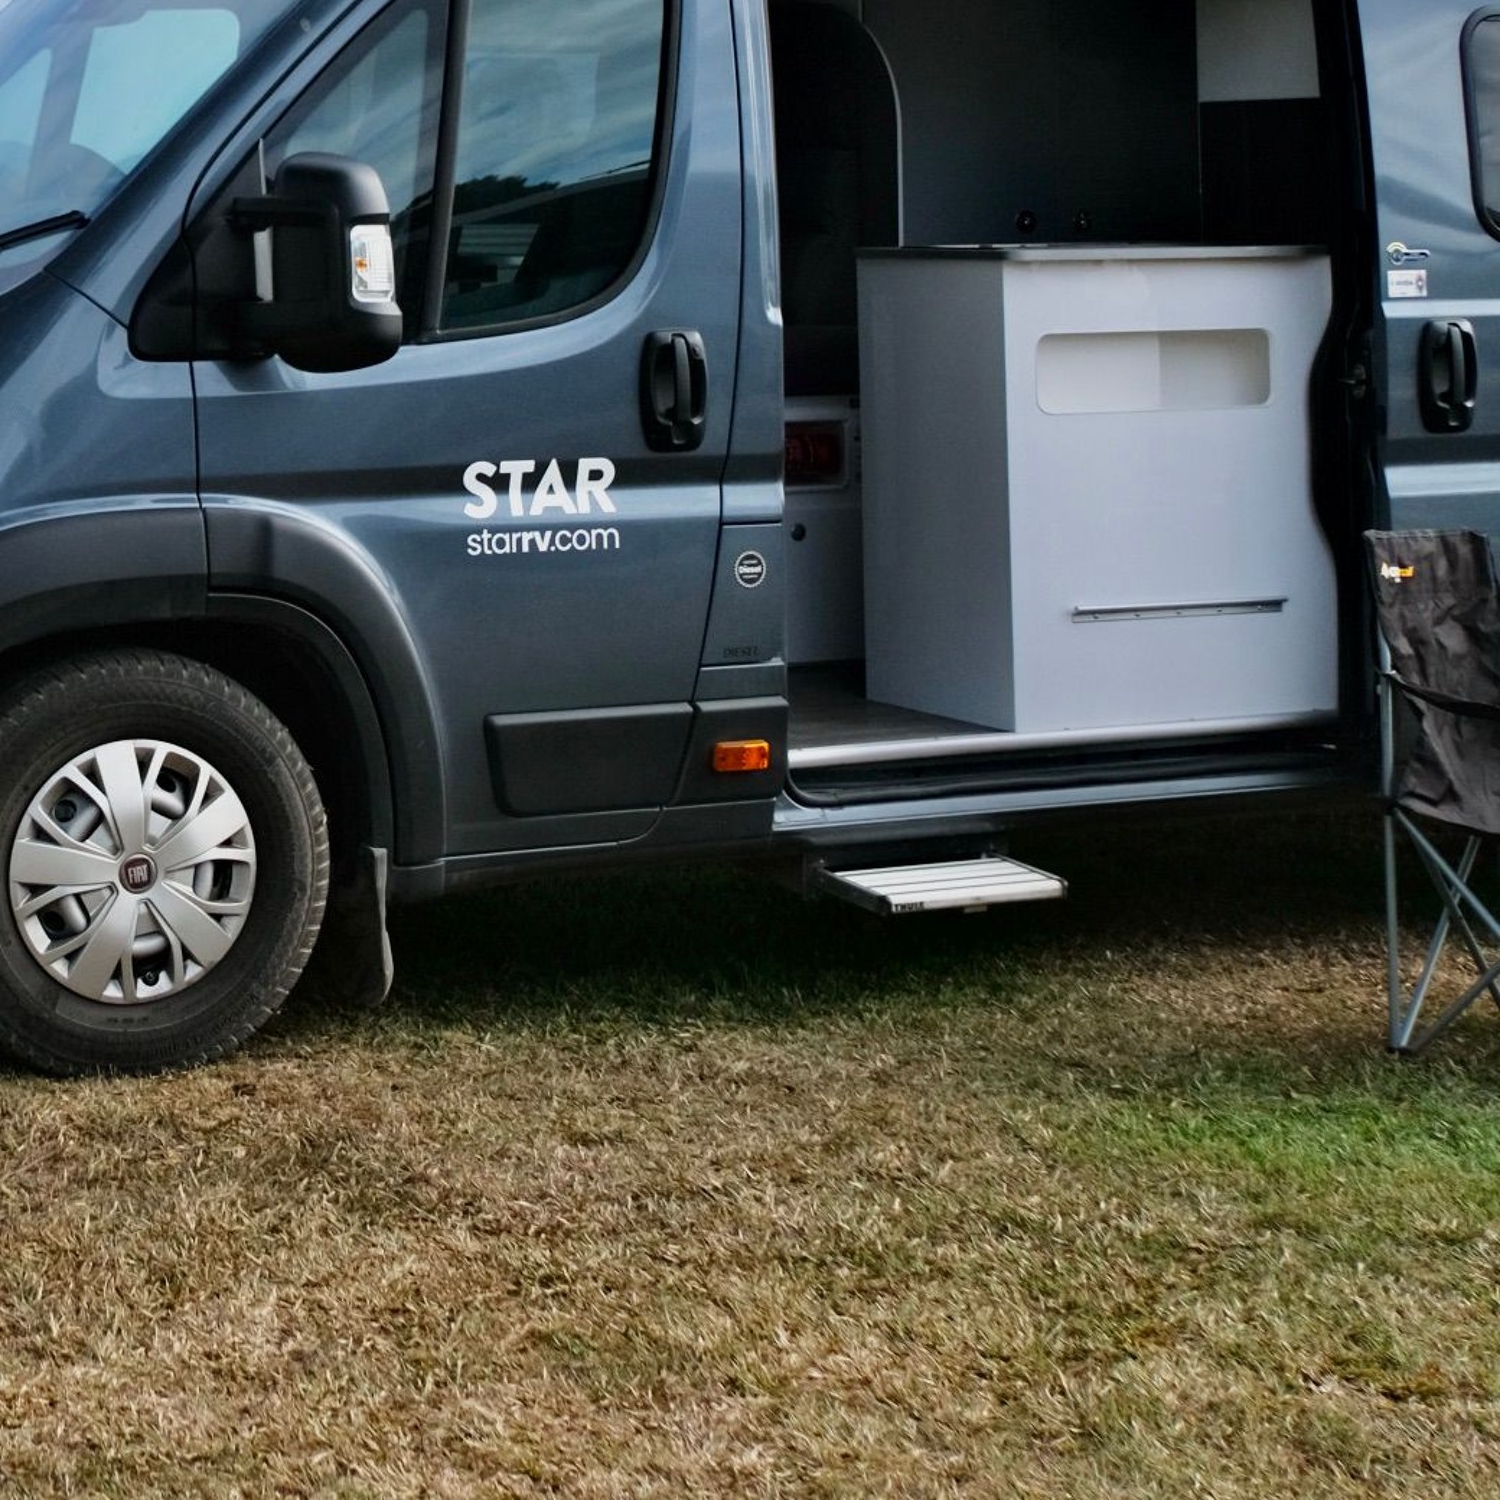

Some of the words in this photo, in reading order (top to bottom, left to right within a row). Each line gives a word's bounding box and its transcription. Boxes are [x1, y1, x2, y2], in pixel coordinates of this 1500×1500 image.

[462, 457, 617, 519] STAR
[466, 527, 620, 556] starrv.com
[127, 864, 149, 884] FIAT
